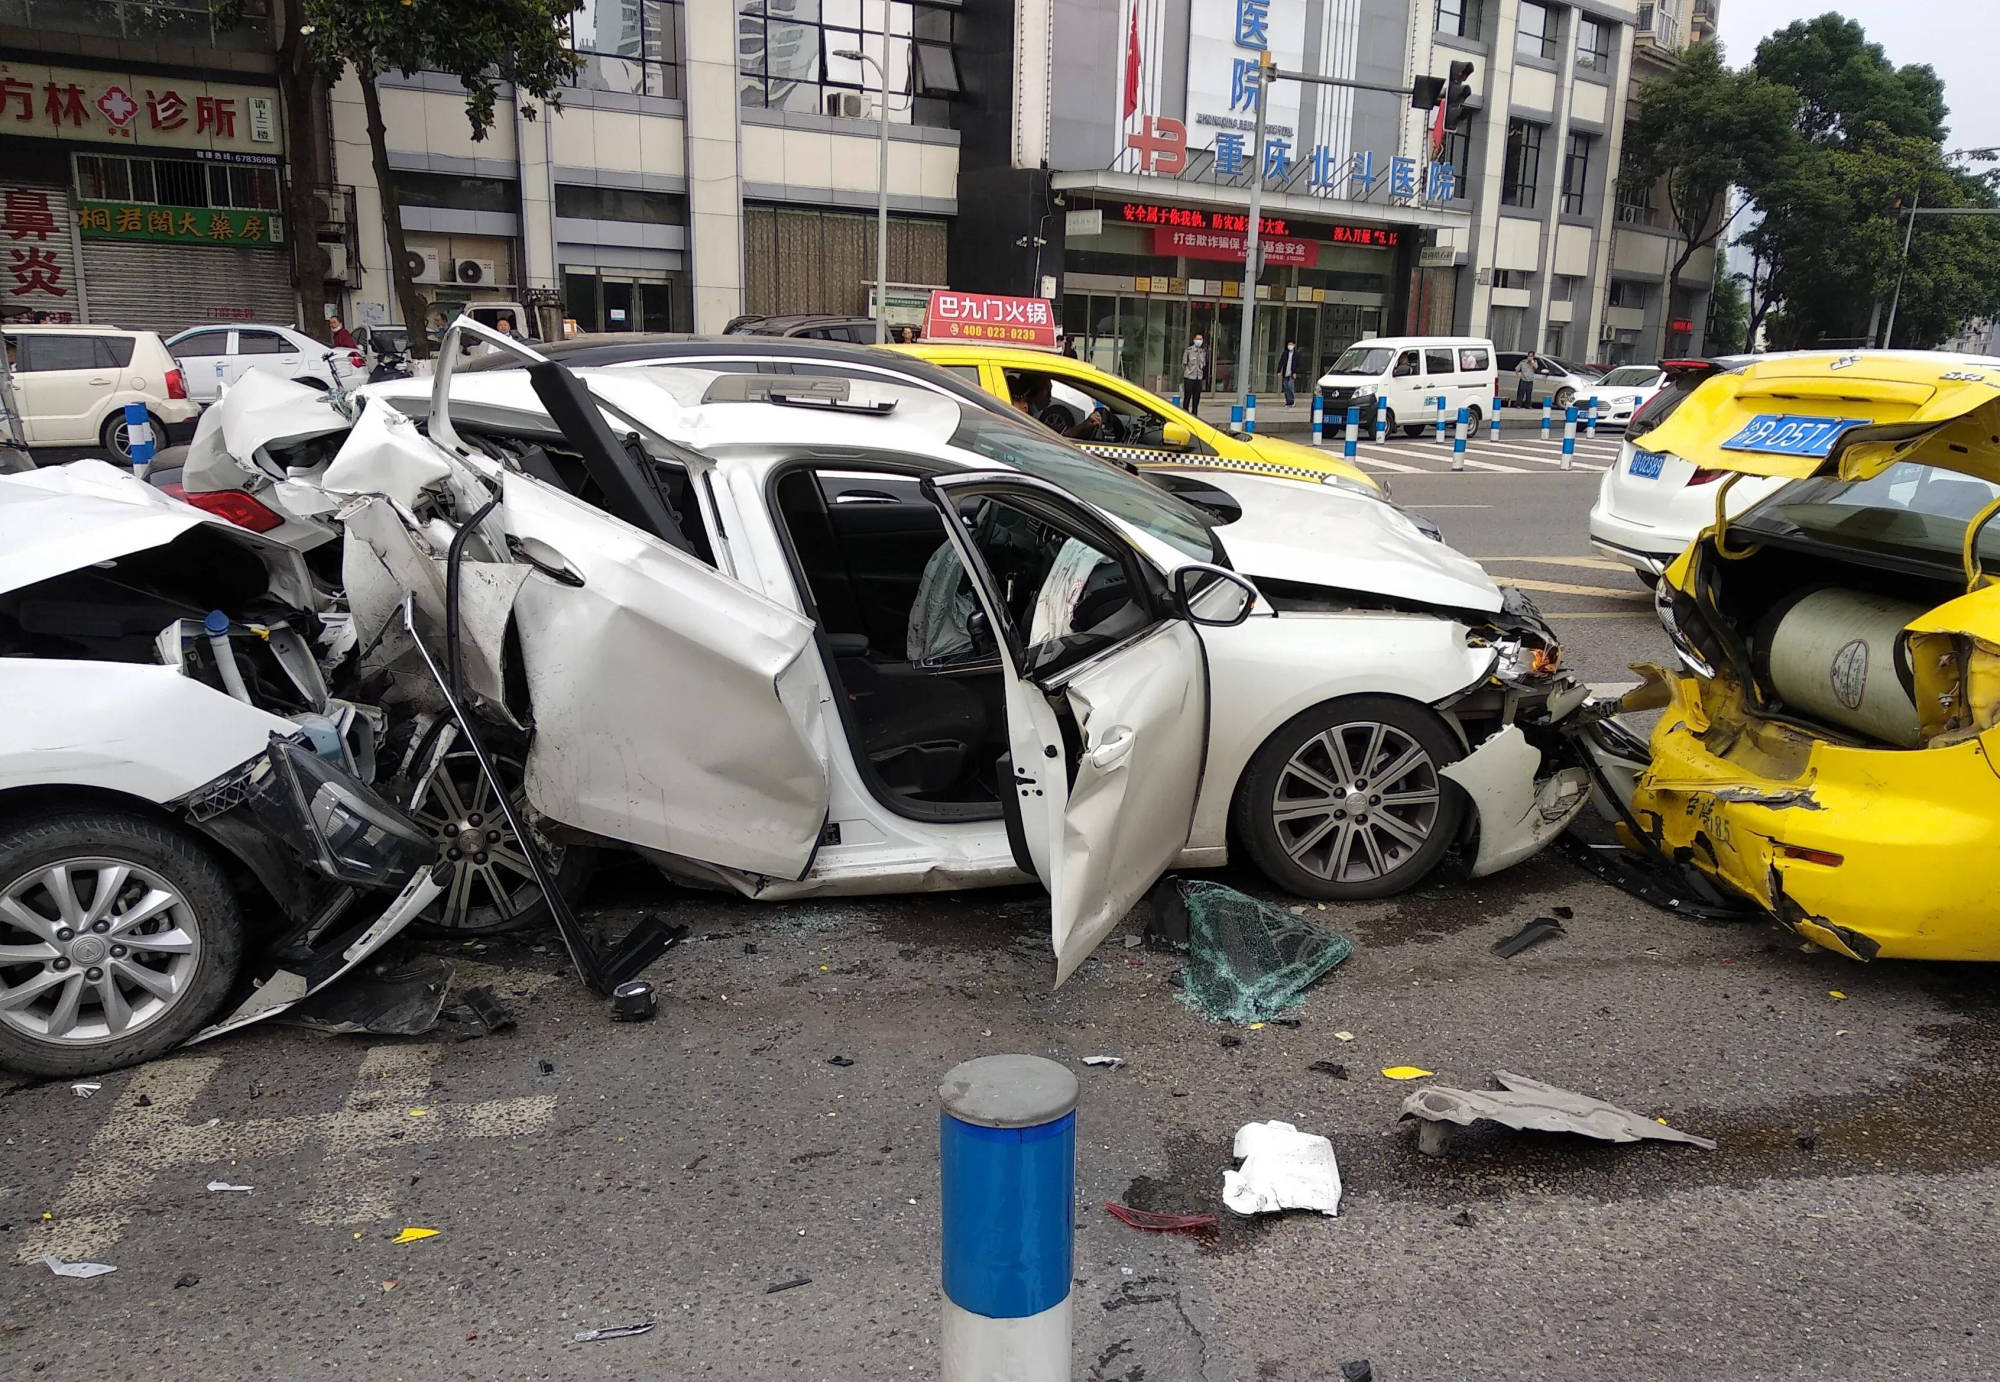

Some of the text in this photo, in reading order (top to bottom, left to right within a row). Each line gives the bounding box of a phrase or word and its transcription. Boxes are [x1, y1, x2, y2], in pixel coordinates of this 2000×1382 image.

[146, 89, 237, 138] 诊所
[254, 98, 270, 140] 请上二楼
[1214, 131, 1456, 201] 重庆北斗医院
[0, 188, 68, 297] 鼻炎
[939, 295, 1047, 325] 巴九门火锅
[963, 327, 1036, 341] 400-023-0239
